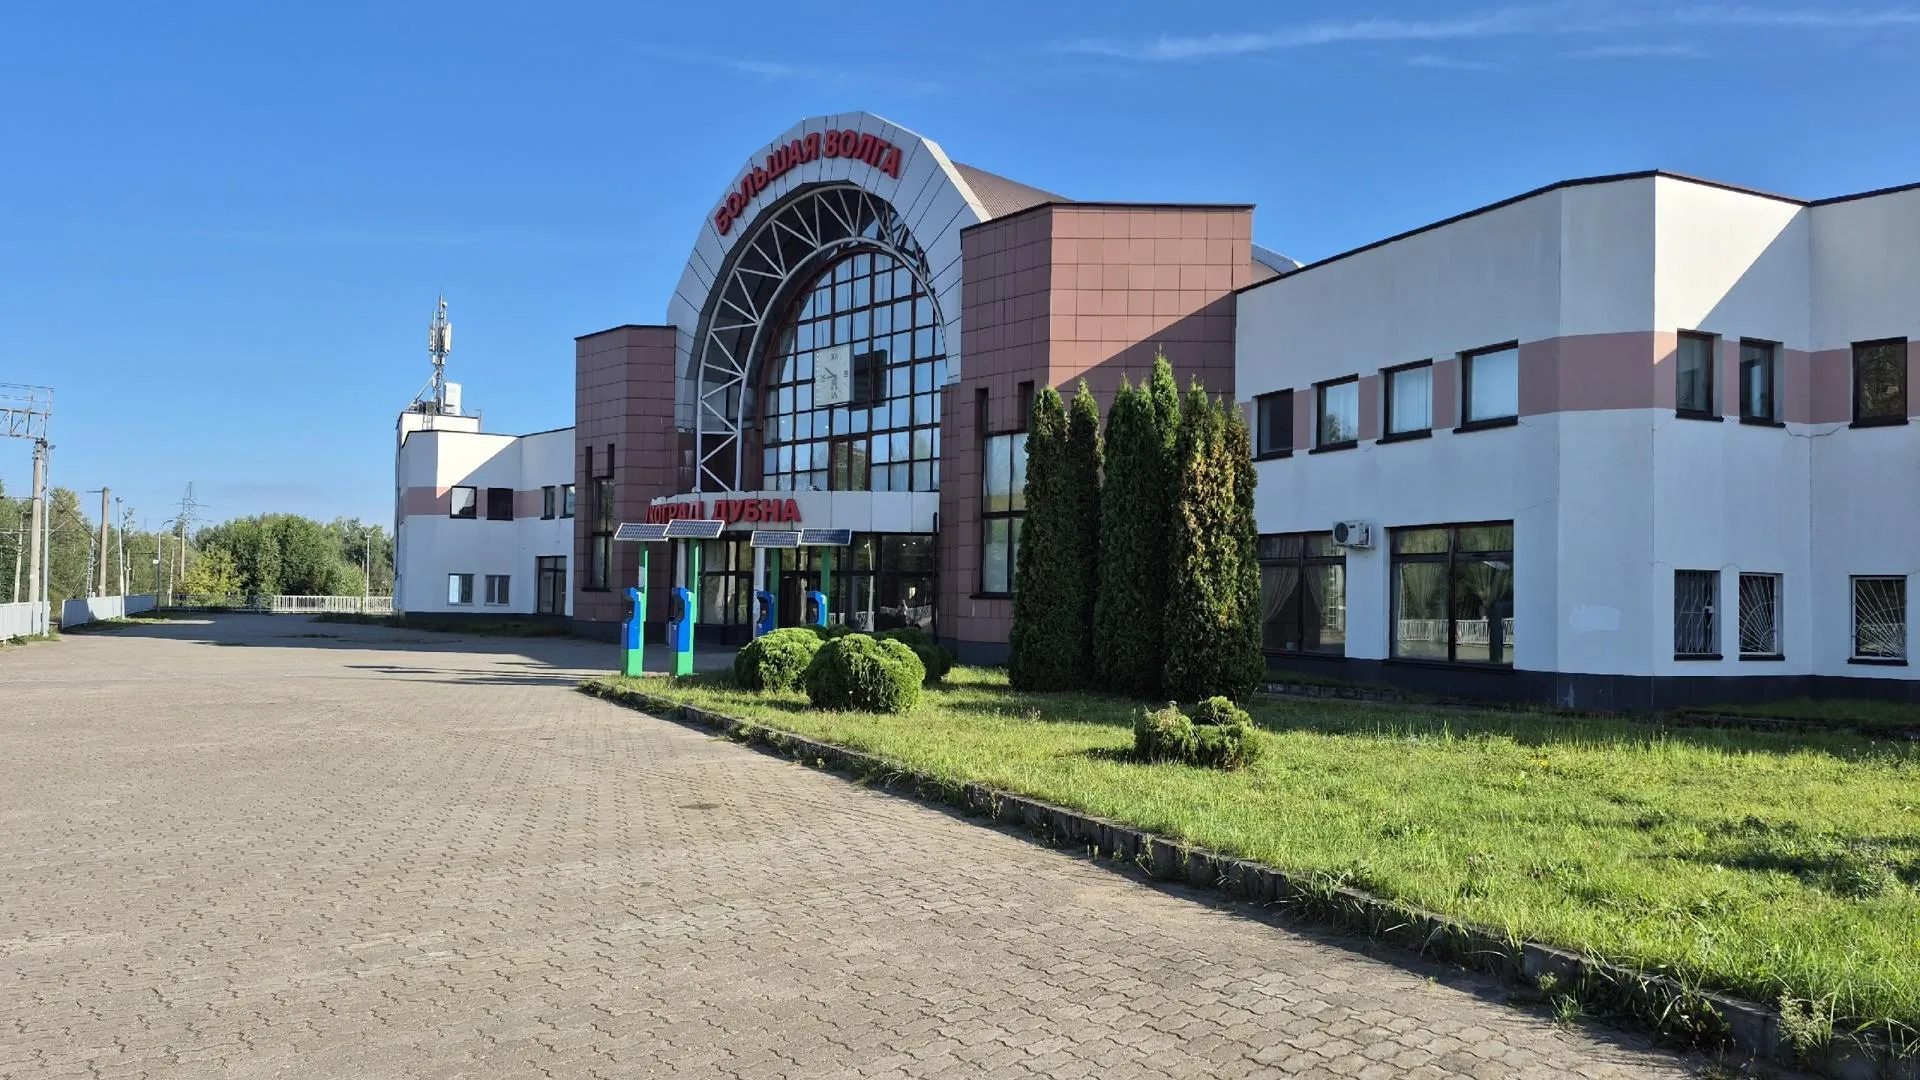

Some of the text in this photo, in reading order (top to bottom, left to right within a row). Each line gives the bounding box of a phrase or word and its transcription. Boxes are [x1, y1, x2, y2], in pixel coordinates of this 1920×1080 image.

[714, 129, 903, 236] БОЛЬШАЯ ВОЛГА
[712, 498, 802, 525] ДУБНА
